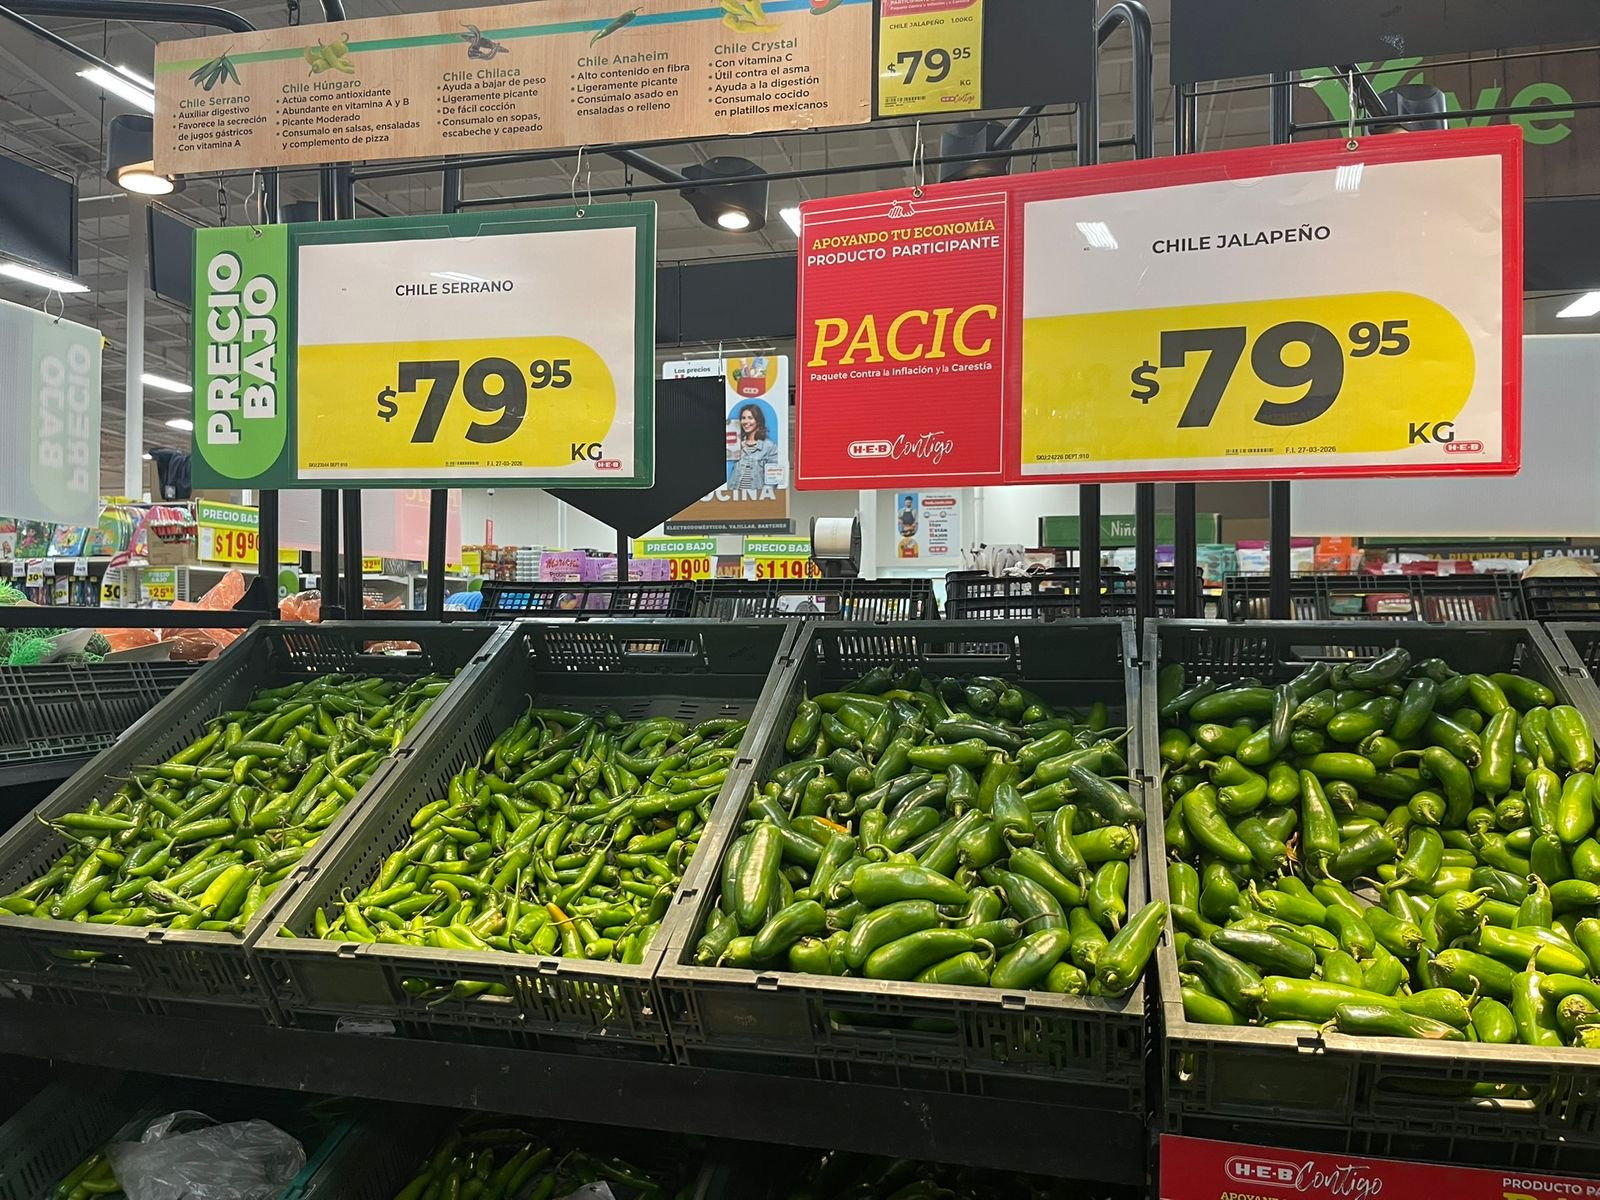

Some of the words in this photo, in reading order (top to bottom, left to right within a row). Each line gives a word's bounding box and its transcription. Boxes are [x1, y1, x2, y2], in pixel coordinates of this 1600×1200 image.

[909, 19, 944, 27] JALAPEÑO
[714, 44, 746, 55] Chile
[752, 38, 797, 52] Crystal
[578, 56, 608, 67] Chile
[613, 51, 668, 64] Anaheim
[715, 60, 735, 68] Con
[738, 55, 782, 66] vitamina
[786, 53, 792, 61] C
[443, 71, 472, 81] Chile
[477, 68, 520, 79] Chilaca
[577, 72, 597, 80] Alto
[601, 67, 649, 78] contenido
[668, 64, 689, 72] fibra
[715, 70, 732, 80] Útil
[736, 68, 767, 78] contra
[771, 67, 779, 75] el
[783, 65, 810, 73] asma
[283, 84, 309, 93] Chile
[314, 80, 361, 91] Húngaro
[443, 82, 471, 92] Ayuda
[483, 80, 506, 89] bajar
[523, 77, 546, 85] peso
[577, 80, 638, 93] Ligeramente
[641, 77, 677, 88] picante
[715, 83, 747, 93] Ayuda
[771, 76, 819, 88] digestión
[180, 99, 205, 108] Chile
[209, 96, 250, 106] Serrano
[282, 95, 306, 104] Actúa
[336, 89, 391, 100] antioxidante
[443, 92, 500, 104] Ligeramente
[503, 90, 538, 99] picante
[634, 90, 663, 99] asado
[715, 93, 771, 104] Consumalo
[775, 90, 809, 99] cocido
[179, 110, 209, 119] Auxiliar
[212, 106, 249, 116] digestivo
[282, 105, 329, 115] Abundante
[345, 100, 382, 110] vitamina
[396, 100, 400, 108] y
[458, 105, 476, 113] fácil
[480, 102, 515, 112] cocción
[577, 106, 624, 116] ensaladas
[637, 102, 670, 111] relleno
[730, 105, 769, 117] platillos
[773, 101, 828, 112] mexicanos
[179, 121, 215, 129] Favorece
[227, 115, 266, 125] secreción
[283, 117, 313, 126] Picante
[316, 114, 360, 124] Moderado
[443, 116, 494, 126] Consumalo
[511, 113, 540, 121] sopas,
[191, 132, 213, 141] jugos
[216, 128, 252, 139] gástricos
[282, 127, 330, 137] Consumalo
[346, 123, 373, 132] salsas,
[376, 121, 420, 130] ensaladas
[443, 128, 491, 137] escabeche
[502, 124, 542, 134] capeado
[197, 141, 232, 149] vitamina
[283, 142, 287, 150] y
[290, 137, 349, 148] complemento
[366, 134, 389, 144] pizza
[813, 232, 888, 249] APOYANDO
[891, 229, 912, 241] TU
[915, 218, 995, 239] ECONOMÍA
[1152, 236, 1210, 254] CHILE
[1217, 225, 1330, 249] JALAPEÑO
[808, 249, 886, 267] PRODUCTO
[893, 236, 999, 257] PARTICIPANTE
[396, 283, 438, 296] CHILE
[442, 280, 513, 295] SERRANO
[808, 304, 997, 367] PACIC
[208, 252, 241, 444] PRECIO
[244, 276, 277, 418] BAJO
[811, 371, 847, 381] Paquete
[850, 369, 880, 378] Contra
[892, 365, 933, 376] Inflación
[936, 367, 940, 375] y
[952, 362, 992, 372] Carestía
[1409, 422, 1454, 444] KG
[571, 443, 602, 460] KG
[891, 432, 953, 464] Contigo
[203, 509, 239, 521] PRECIO
[241, 514, 259, 523] BAJ
[648, 543, 684, 551] PRECIO
[749, 544, 786, 552] PRECIO
[1295, 1161, 1382, 1200] Contigo
[1503, 1178, 1582, 1195] PRODUCTO
